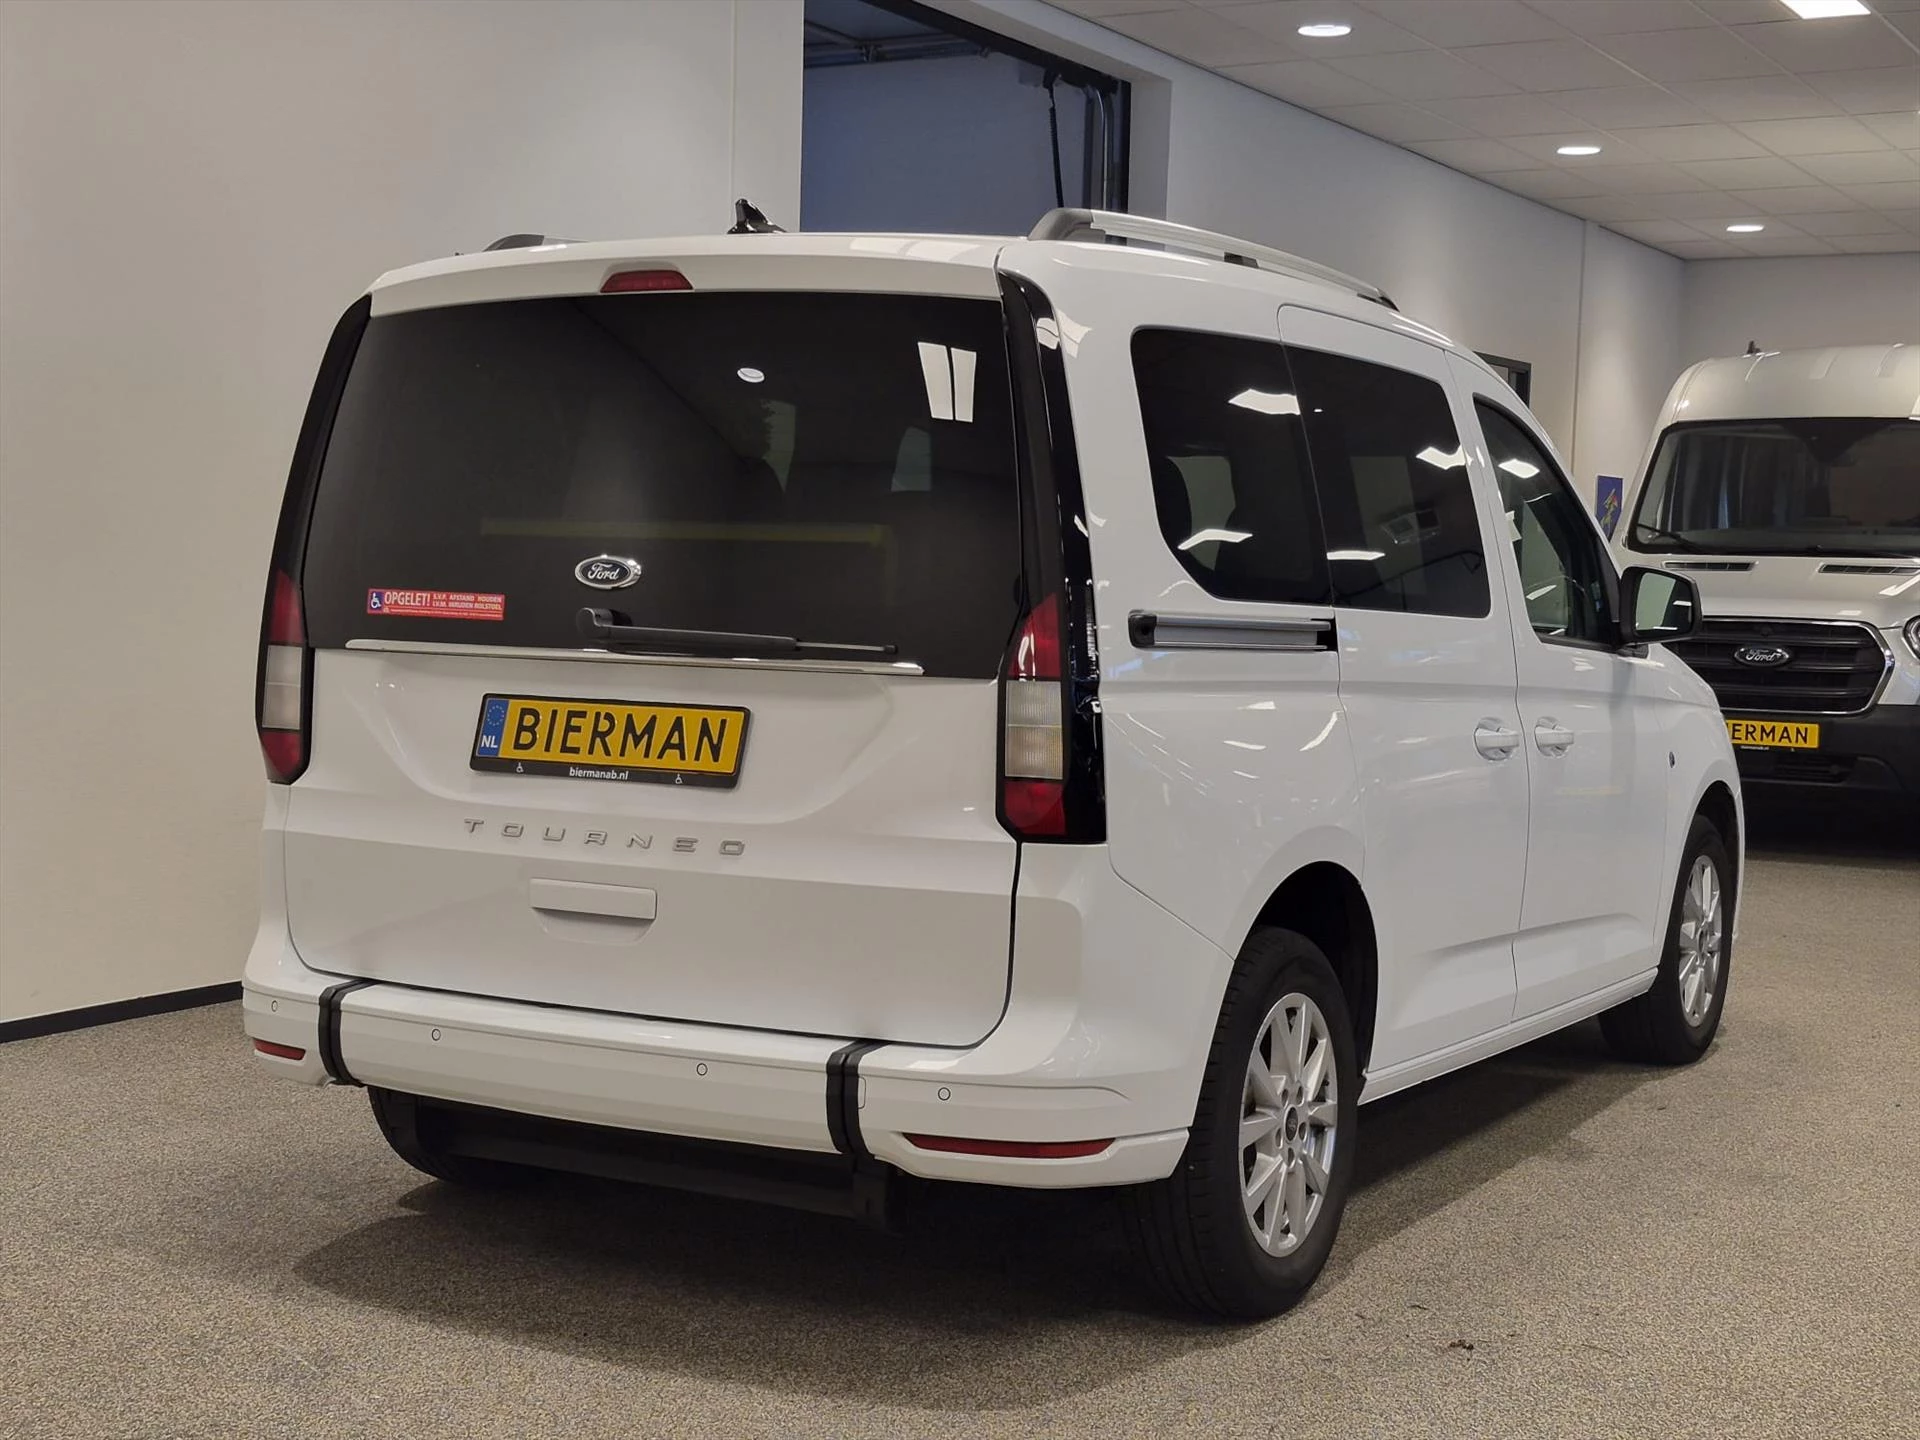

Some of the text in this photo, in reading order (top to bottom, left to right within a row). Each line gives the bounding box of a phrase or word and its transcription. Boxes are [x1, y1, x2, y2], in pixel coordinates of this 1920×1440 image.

[587, 562, 621, 580] Ford
[384, 591, 430, 606] OPGELET!
[1745, 649, 1778, 661] Ford
[481, 735, 498, 749] NL
[513, 707, 728, 763] BIERMAN
[569, 766, 629, 781] biermanab.nl
[464, 818, 746, 856] TOURNEO
